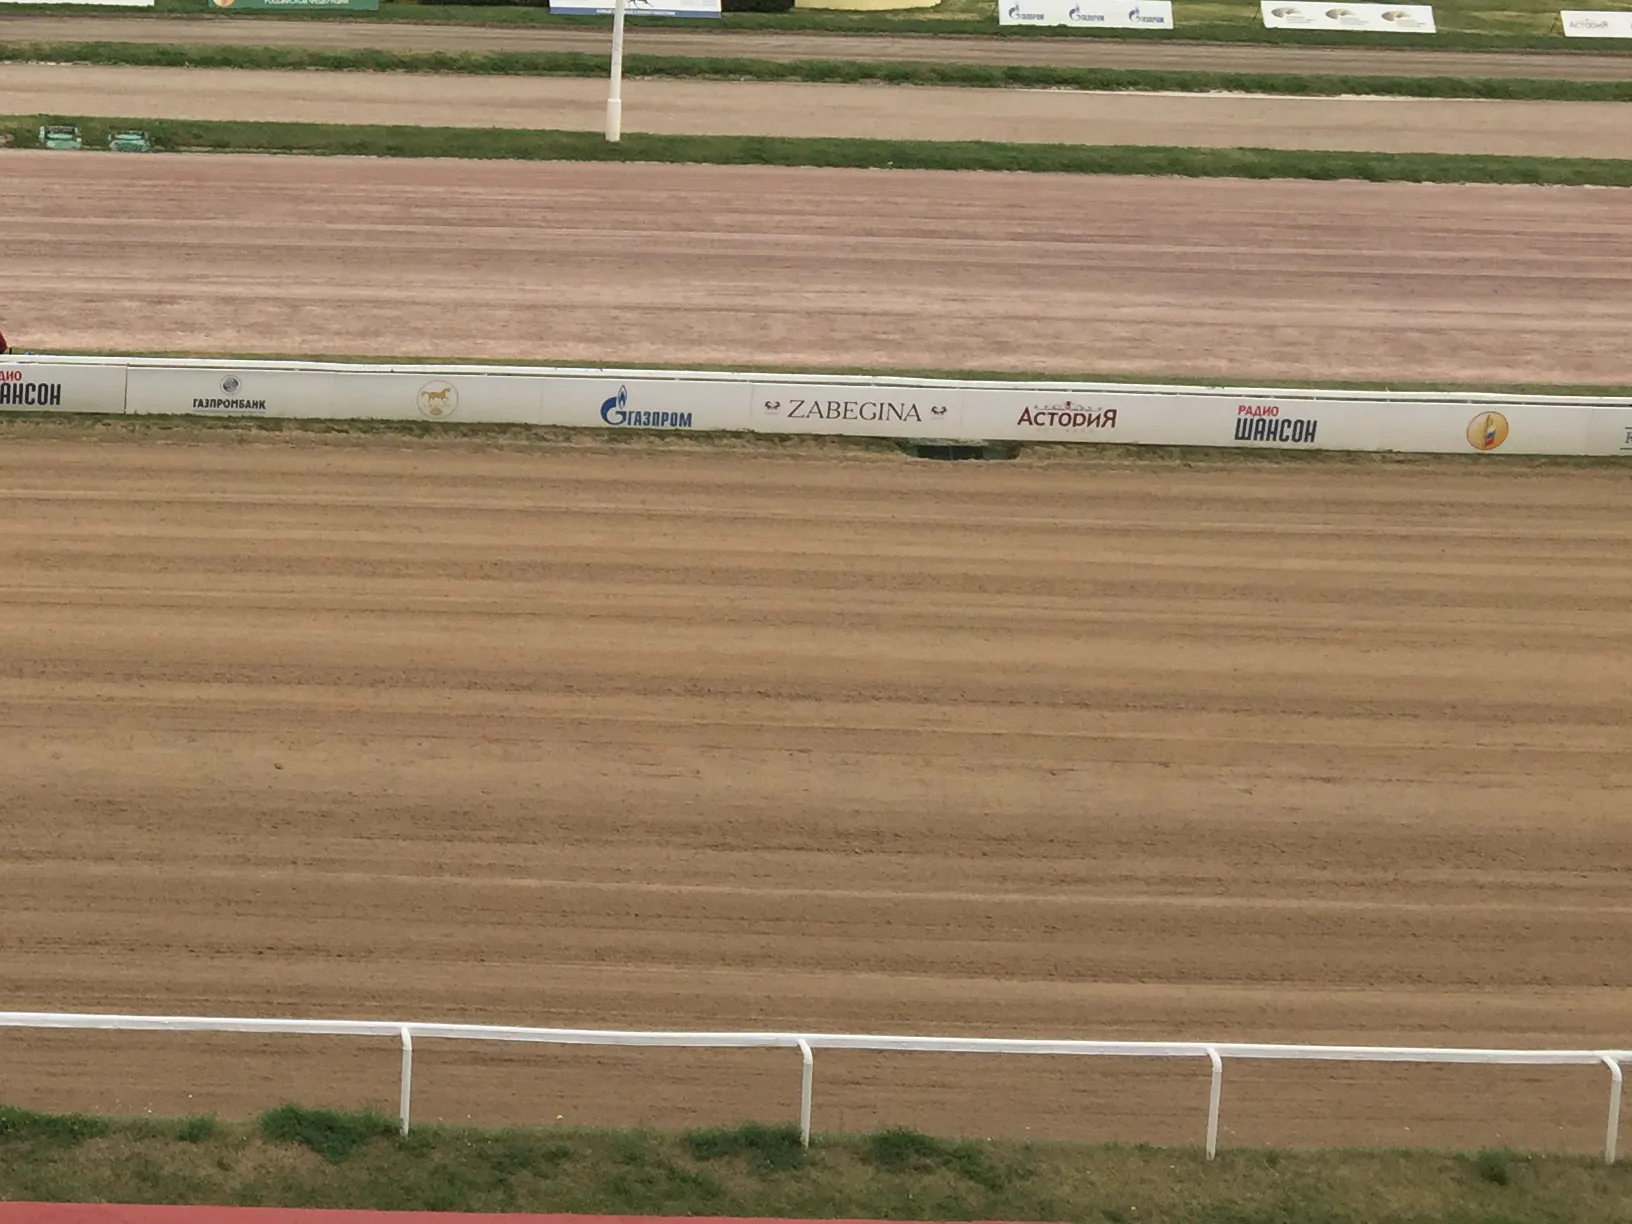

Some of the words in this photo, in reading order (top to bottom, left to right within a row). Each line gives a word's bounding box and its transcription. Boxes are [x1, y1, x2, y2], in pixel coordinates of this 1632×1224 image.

[192, 398, 267, 410] ГАЗПРОМБАНК
[787, 399, 922, 422] ZABEGINA
[1237, 405, 1280, 417] РАДИО
[627, 410, 693, 428] ГАЗПРОМ
[1234, 417, 1318, 443] ШАНСОН
